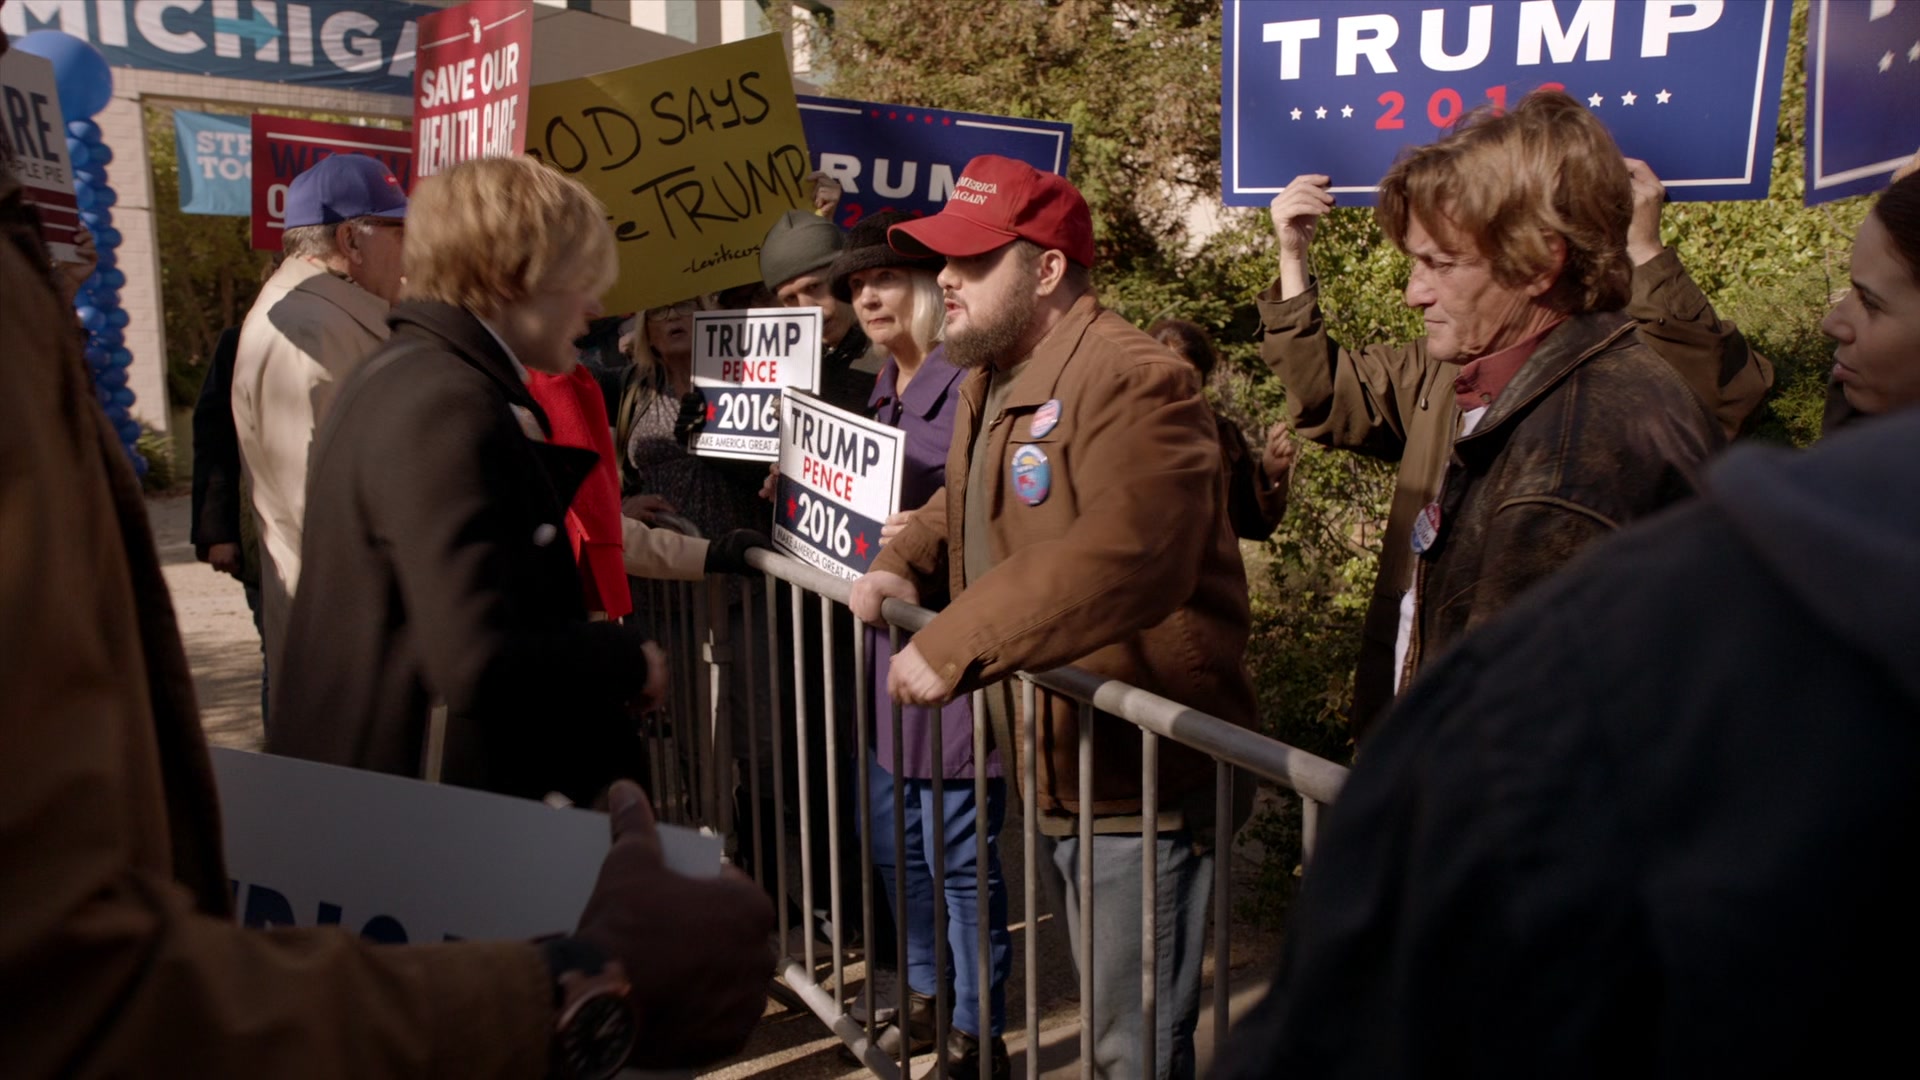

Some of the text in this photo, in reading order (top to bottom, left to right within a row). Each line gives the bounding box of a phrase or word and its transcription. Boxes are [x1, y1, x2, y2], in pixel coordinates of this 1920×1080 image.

[1, 0, 415, 77] MICHIGA
[1262, 0, 1725, 80] TRUMP
[420, 42, 520, 108] SAVE OUR
[1375, 82, 1566, 130] 201
[2, 85, 60, 163] RE
[418, 108, 478, 177] HEALTH
[483, 94, 518, 158] CARE
[526, 71, 770, 174] OD SAYS
[631, 144, 806, 240] TRUMP
[951, 189, 988, 206] AGAIN
[706, 322, 800, 357] TRUMP
[722, 361, 777, 383] PENCE
[715, 436, 747, 450] AMERICA
[748, 439, 772, 452] GREAT
[718, 392, 778, 432] 2016
[791, 407, 880, 477] TRUMP
[803, 456, 854, 501] PENCE
[777, 529, 793, 549] MAKE
[793, 541, 820, 565] AMERICA
[821, 556, 844, 578] GREAT
[796, 493, 852, 558] 2016
